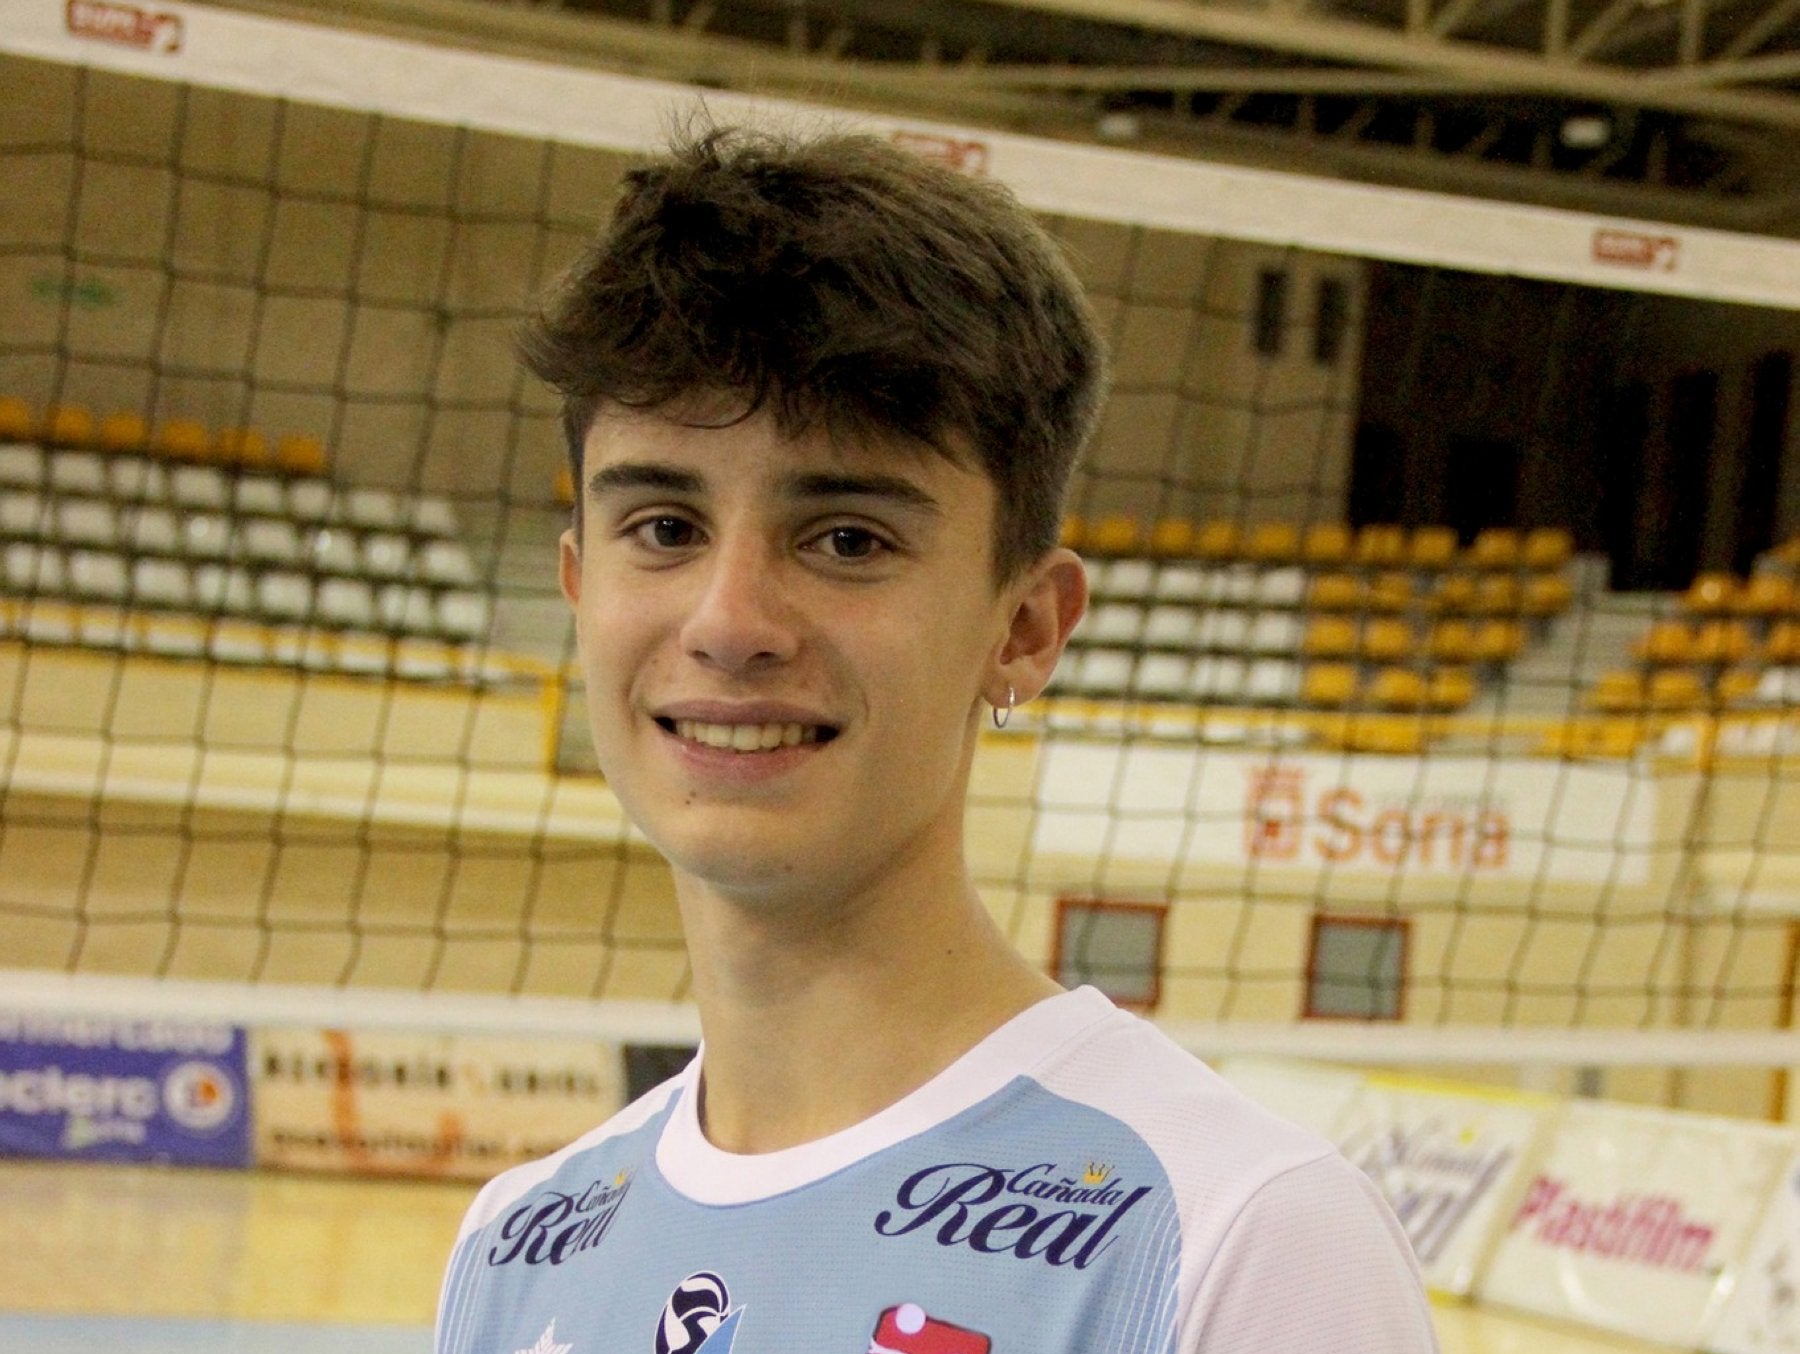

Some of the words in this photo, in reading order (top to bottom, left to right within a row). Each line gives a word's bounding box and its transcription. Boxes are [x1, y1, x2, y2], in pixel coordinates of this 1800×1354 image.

[488, 1180, 632, 1266] Real
[873, 1163, 1153, 1270] Real
[1005, 1163, 1124, 1206] Cañada
